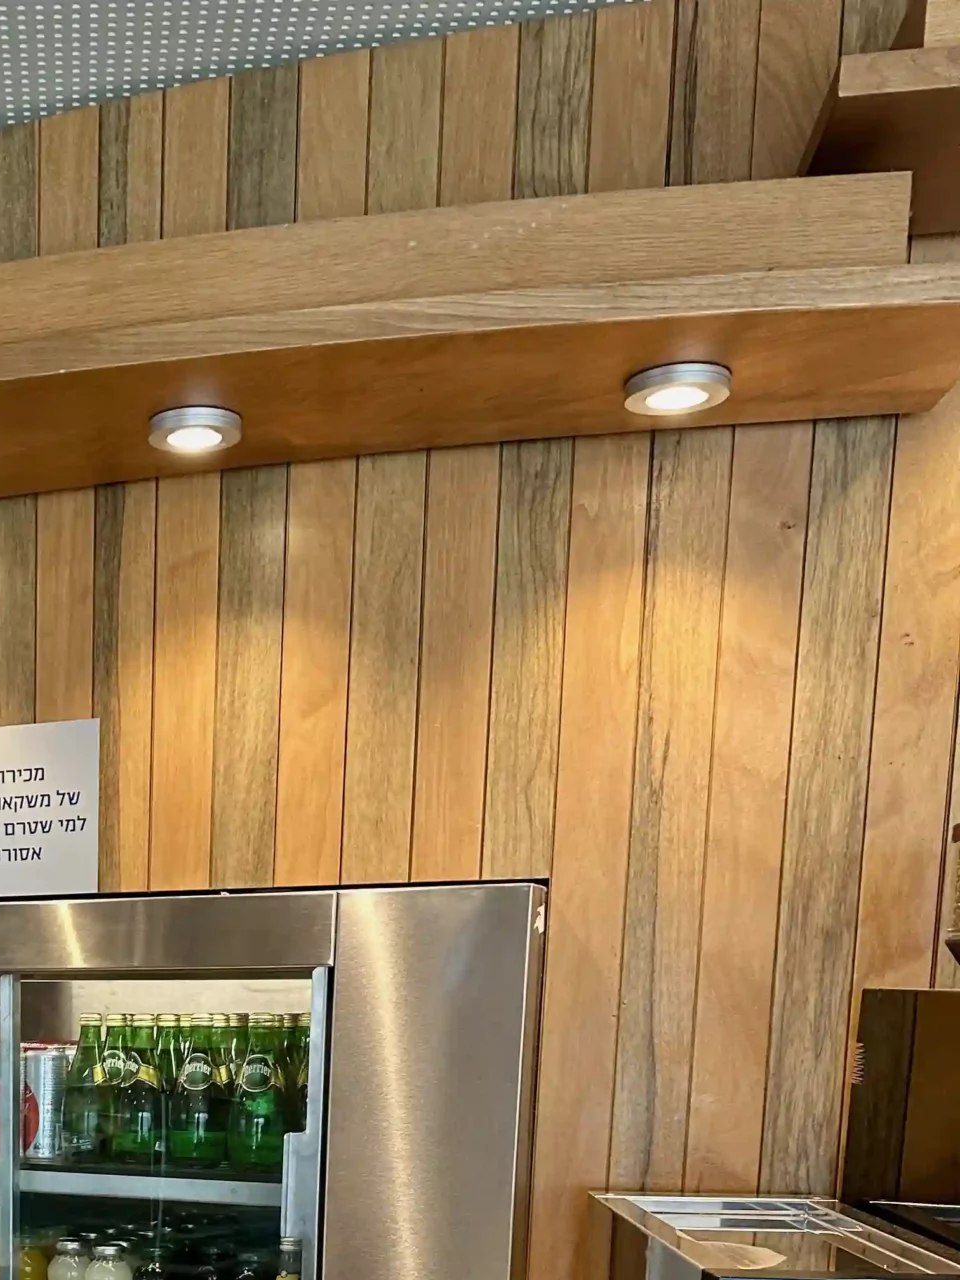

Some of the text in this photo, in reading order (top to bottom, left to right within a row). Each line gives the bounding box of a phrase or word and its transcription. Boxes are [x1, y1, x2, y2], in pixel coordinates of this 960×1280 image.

[55, 790, 81, 807] של
[3, 819, 54, 837] שטרם
[57, 814, 88, 833] למי
